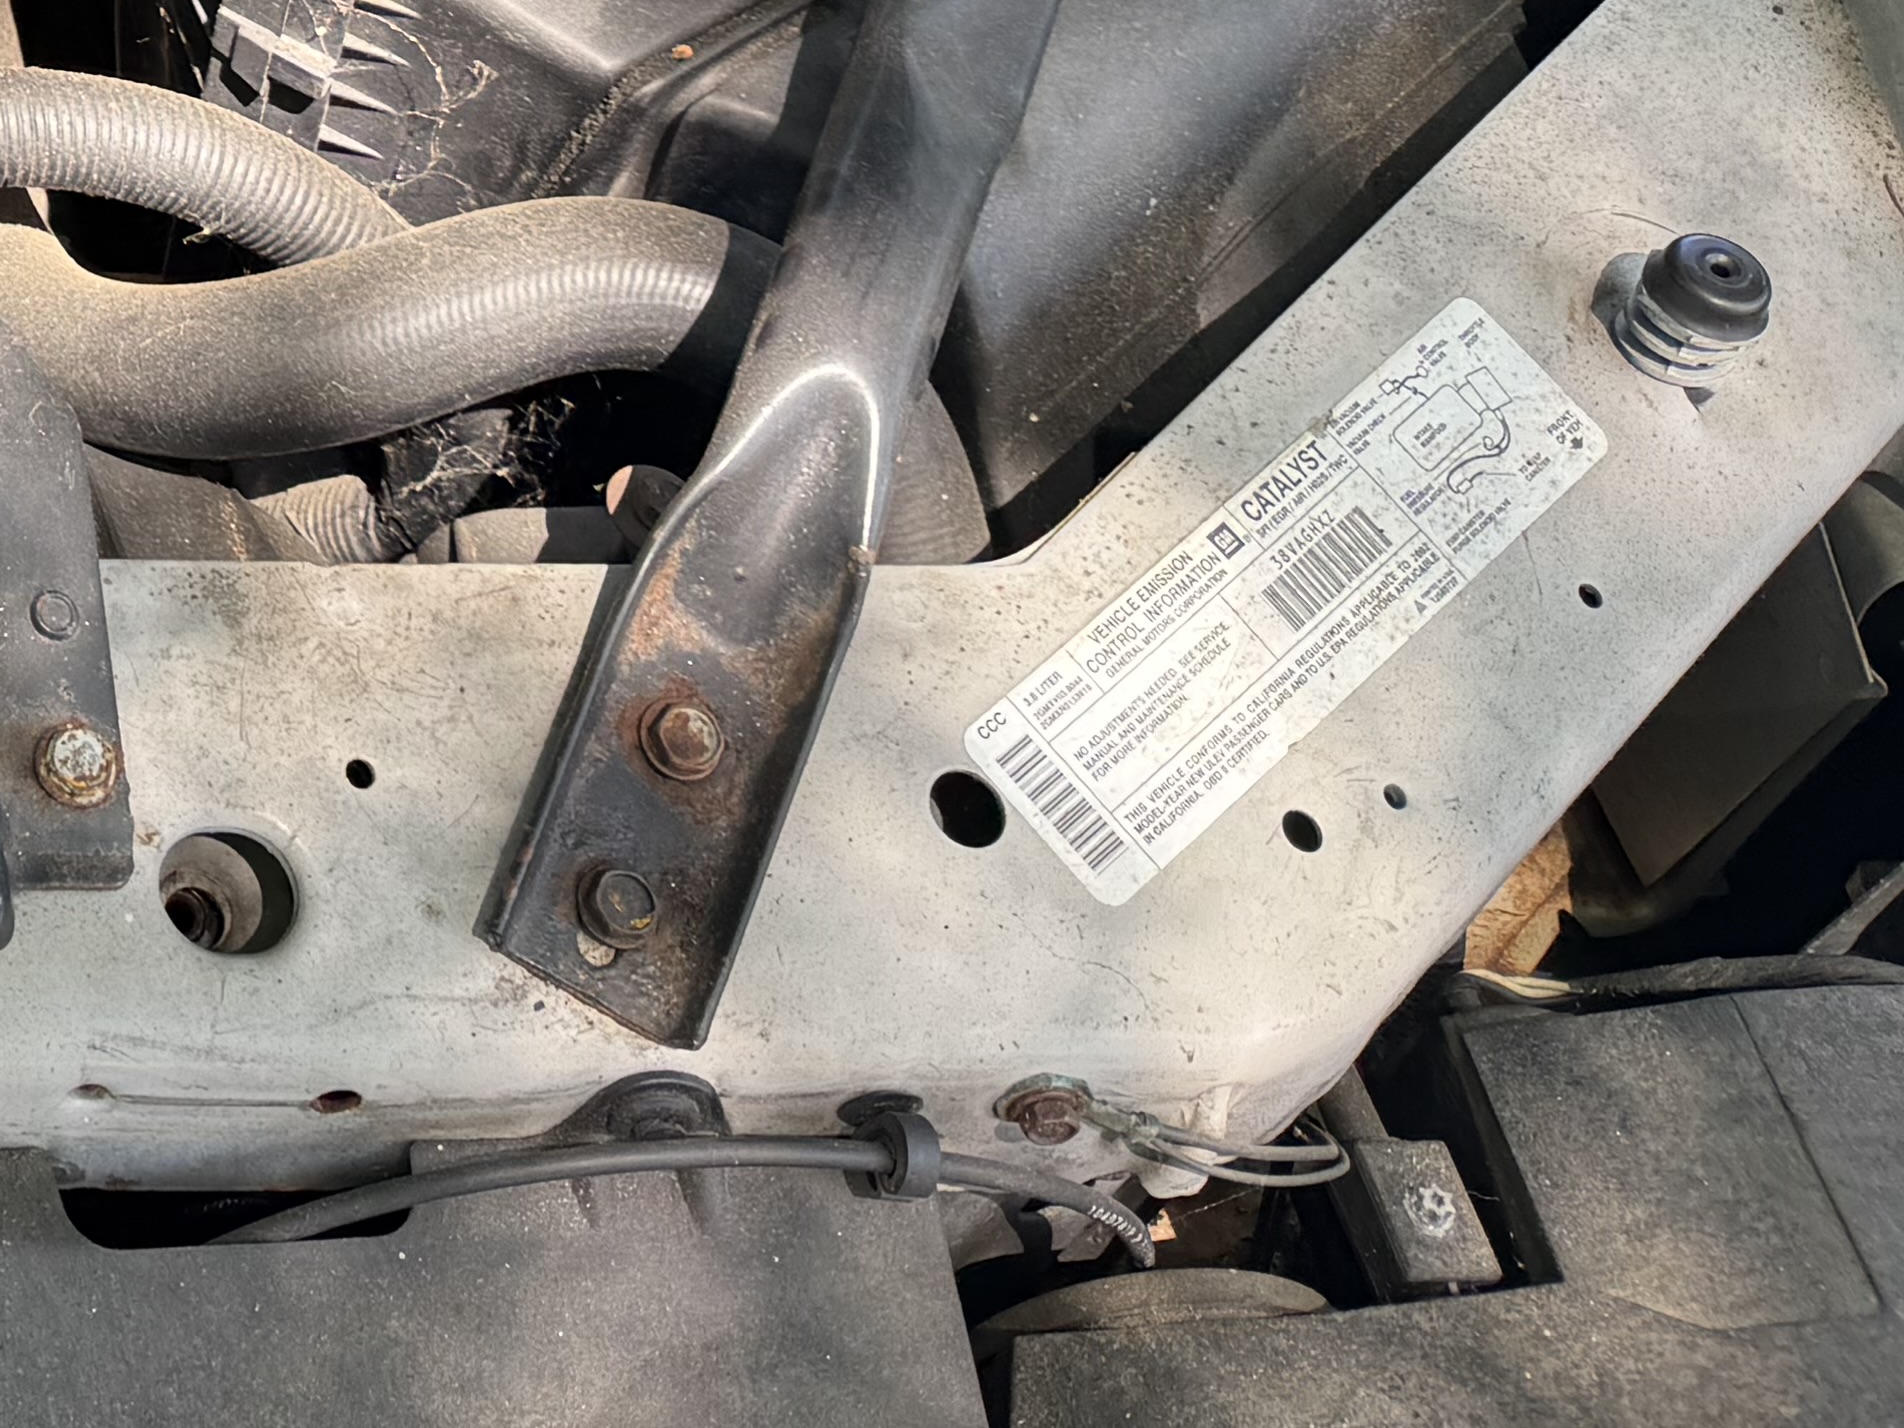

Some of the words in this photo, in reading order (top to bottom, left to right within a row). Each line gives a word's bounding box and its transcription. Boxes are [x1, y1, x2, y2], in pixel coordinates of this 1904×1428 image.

[1545, 408, 1575, 436] FRONT
[1554, 430, 1570, 445] OF
[1564, 416, 1585, 436] VEH
[1237, 438, 1331, 524] CATALYST
[1083, 617, 1146, 676] CONTROL
[1142, 549, 1223, 624] INFORMATION
[1086, 595, 1142, 647] VEHICLE
[1134, 548, 1194, 604] EMISSION
[1104, 640, 1146, 679] GENERAL
[1140, 612, 1177, 647] MOTORS
[1172, 565, 1229, 619] CORPORATION
[974, 709, 1009, 742] CCC
[1072, 744, 1091, 763] NO
[1086, 693, 1147, 751] ADJUSTMENTS
[1176, 647, 1199, 669] SEE
[1192, 619, 1231, 655] SERVICE
[1081, 736, 1120, 773] MANUAL
[1114, 720, 1138, 742] AND
[1133, 672, 1191, 726] MAINTENANCE
[1186, 636, 1232, 678] SCHEDULE
[1122, 800, 1149, 825] THIS
[1145, 765, 1187, 805] VEHICLE
[1183, 722, 1234, 771] CONFORMS
[1231, 710, 1248, 726] TO
[1244, 665, 1297, 715] CALIFORNIA
[1293, 614, 1352, 670] REGULATIONS
[1347, 569, 1400, 619] APPLICABLE
[1395, 558, 1412, 574] TO
[1132, 782, 1189, 836] MODEL-YEAR
[1183, 766, 1207, 789] NEW
[1222, 706, 1272, 753] PASSENGER
[1266, 686, 1294, 713] CARS
[1287, 671, 1310, 693] AND
[1303, 662, 1320, 678] TO
[1328, 635, 1350, 655] EPA
[1343, 590, 1398, 642] REGULATIONS
[1391, 550, 1441, 597] APPLICABLE
[1090, 760, 1114, 782] FOR
[1108, 739, 1137, 766] MORE
[1141, 831, 1157, 846] IN
[1224, 726, 1271, 770] CERTIFIED.
